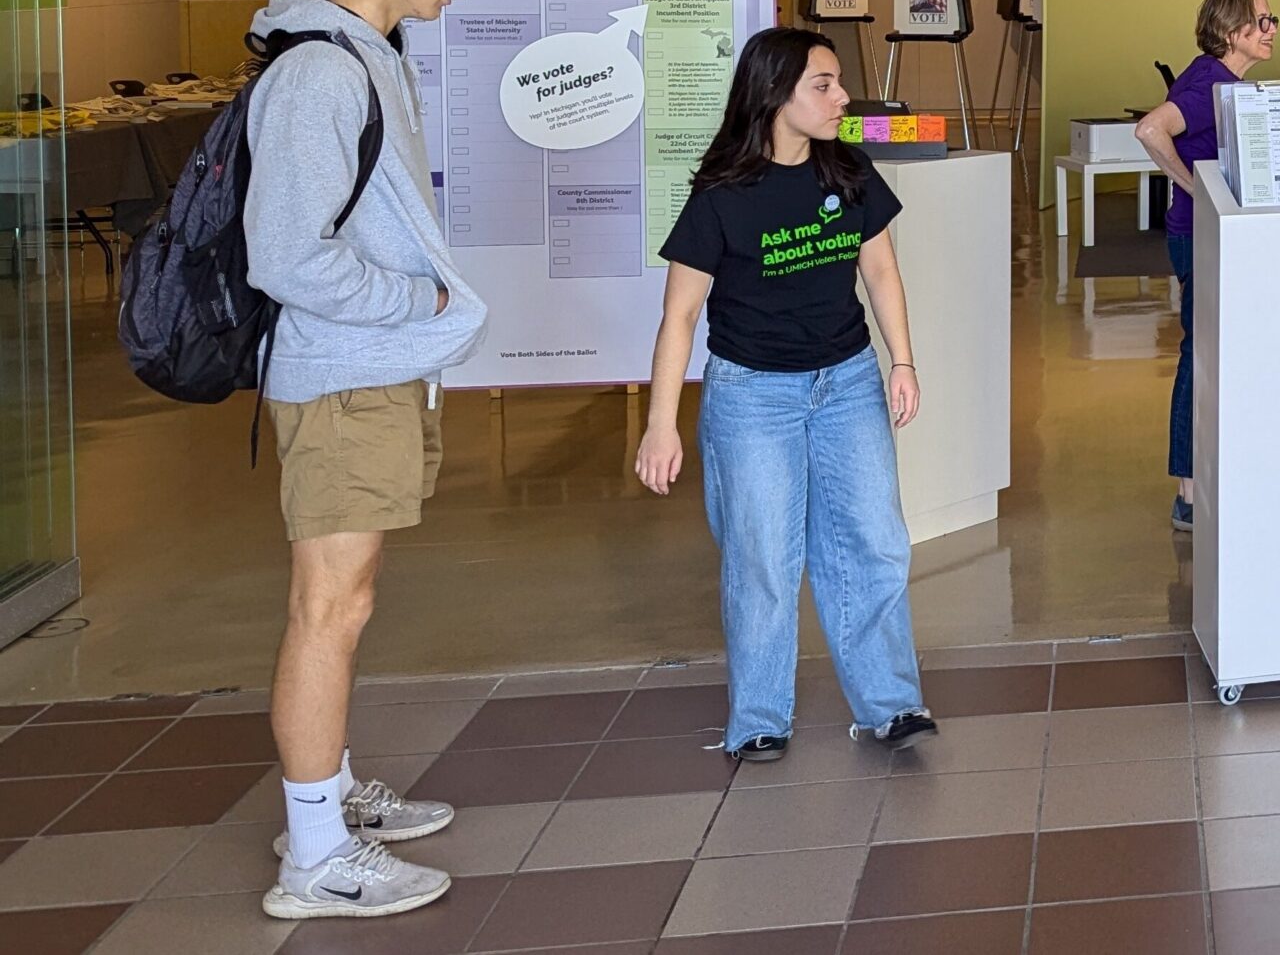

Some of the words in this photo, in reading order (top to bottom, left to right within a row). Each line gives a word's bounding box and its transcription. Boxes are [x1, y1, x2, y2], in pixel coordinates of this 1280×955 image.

[826, 0, 855, 8] VOTE
[495, 19, 527, 27] Michigan
[910, 13, 946, 23] VOTE
[485, 27, 521, 35] University
[516, 73, 540, 87] We
[543, 64, 574, 80] vote
[536, 86, 556, 102] for
[559, 66, 614, 96] judges?
[551, 101, 581, 114] Michigan,
[581, 96, 598, 106] you'll
[598, 92, 612, 100] vote
[556, 110, 578, 122] judges
[588, 99, 614, 112] multiple
[615, 94, 634, 103] levels
[556, 120, 568, 128] the
[568, 116, 586, 125] court
[761, 228, 792, 247] Ask
[794, 223, 822, 240] me
[763, 244, 814, 265] about
[816, 232, 862, 252] voting
[762, 269, 776, 277] I'm
[786, 260, 814, 274] UMICH
[815, 254, 837, 266] Votes
